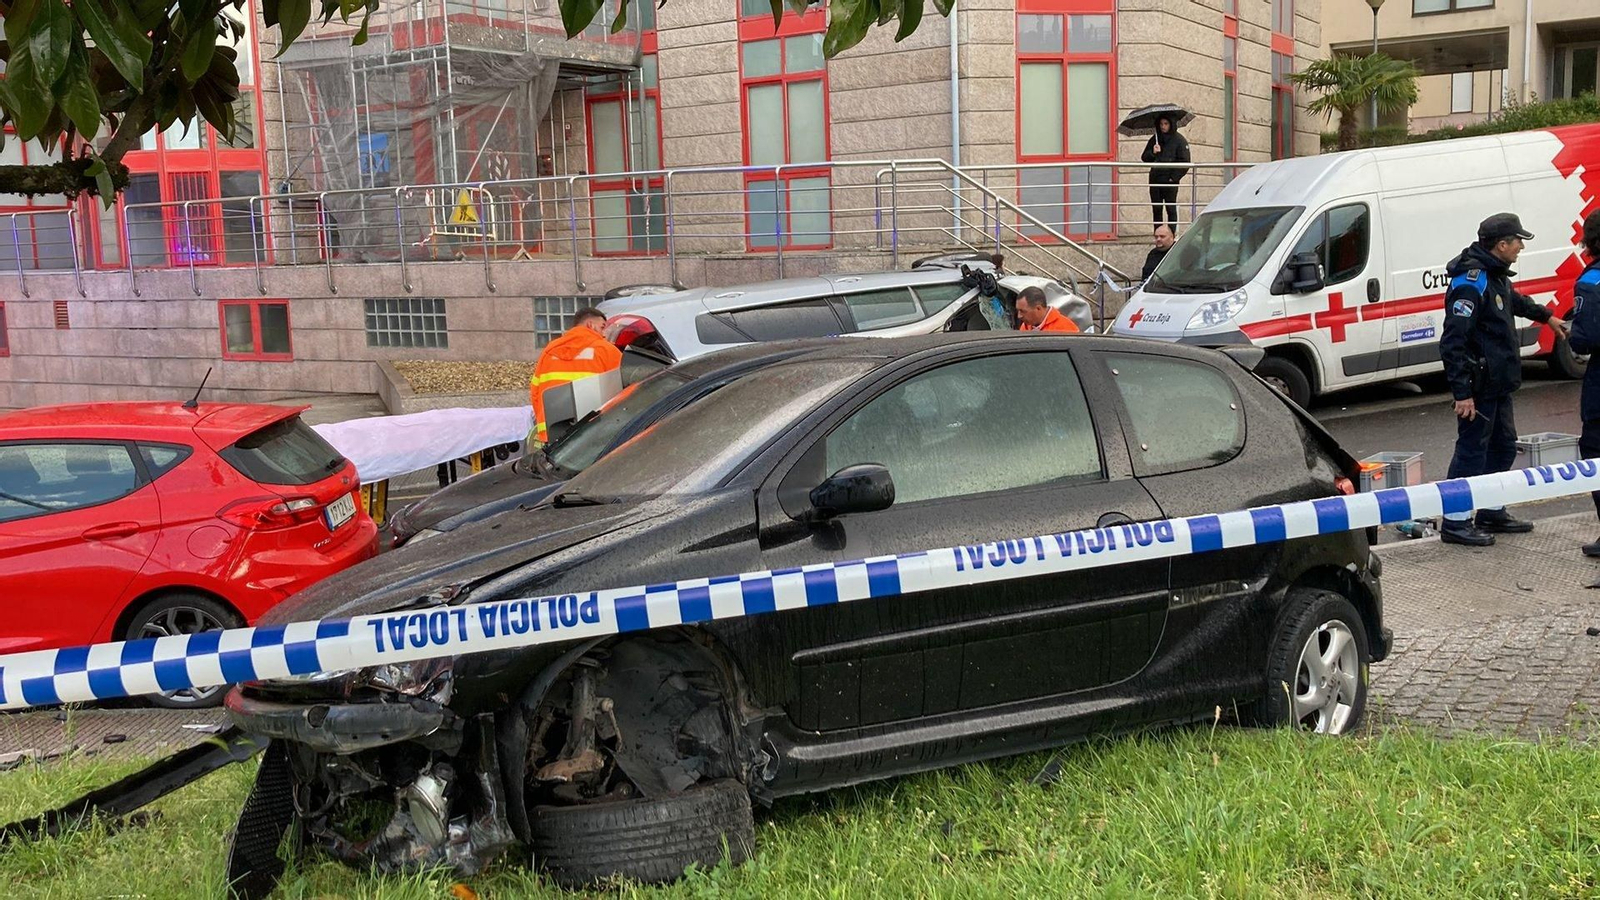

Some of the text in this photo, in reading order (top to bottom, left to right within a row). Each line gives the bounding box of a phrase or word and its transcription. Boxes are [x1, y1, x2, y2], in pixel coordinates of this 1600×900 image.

[1422, 270, 1449, 290] Cru
[1143, 313, 1170, 325] Cruz Roja
[367, 592, 600, 653] POLICIA LOCAL
